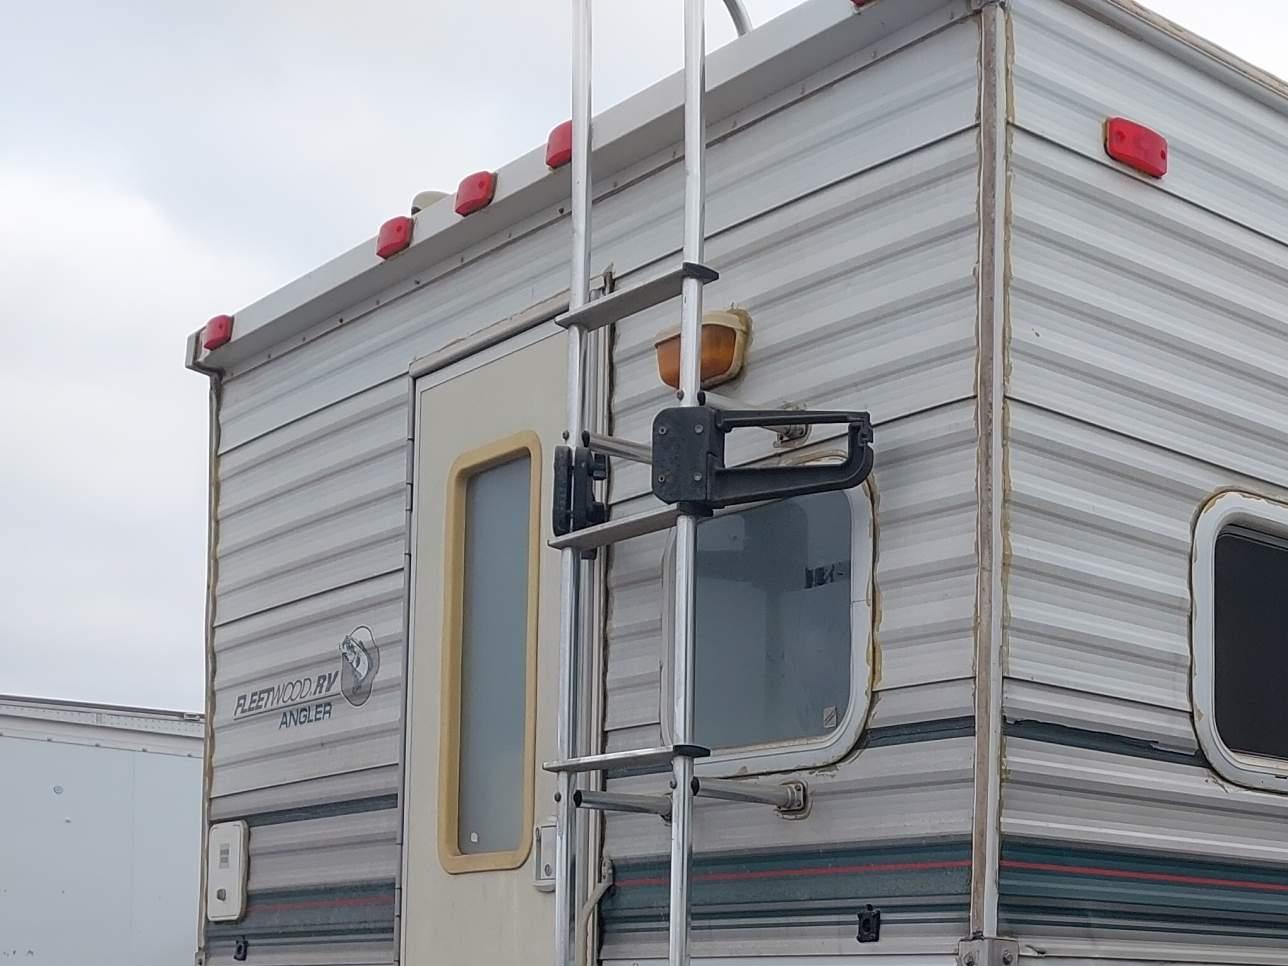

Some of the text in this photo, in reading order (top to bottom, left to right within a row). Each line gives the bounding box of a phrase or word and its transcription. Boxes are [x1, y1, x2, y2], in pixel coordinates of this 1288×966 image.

[233, 670, 340, 718] FLEETWOOD RV
[279, 701, 333, 731] ANGLER
